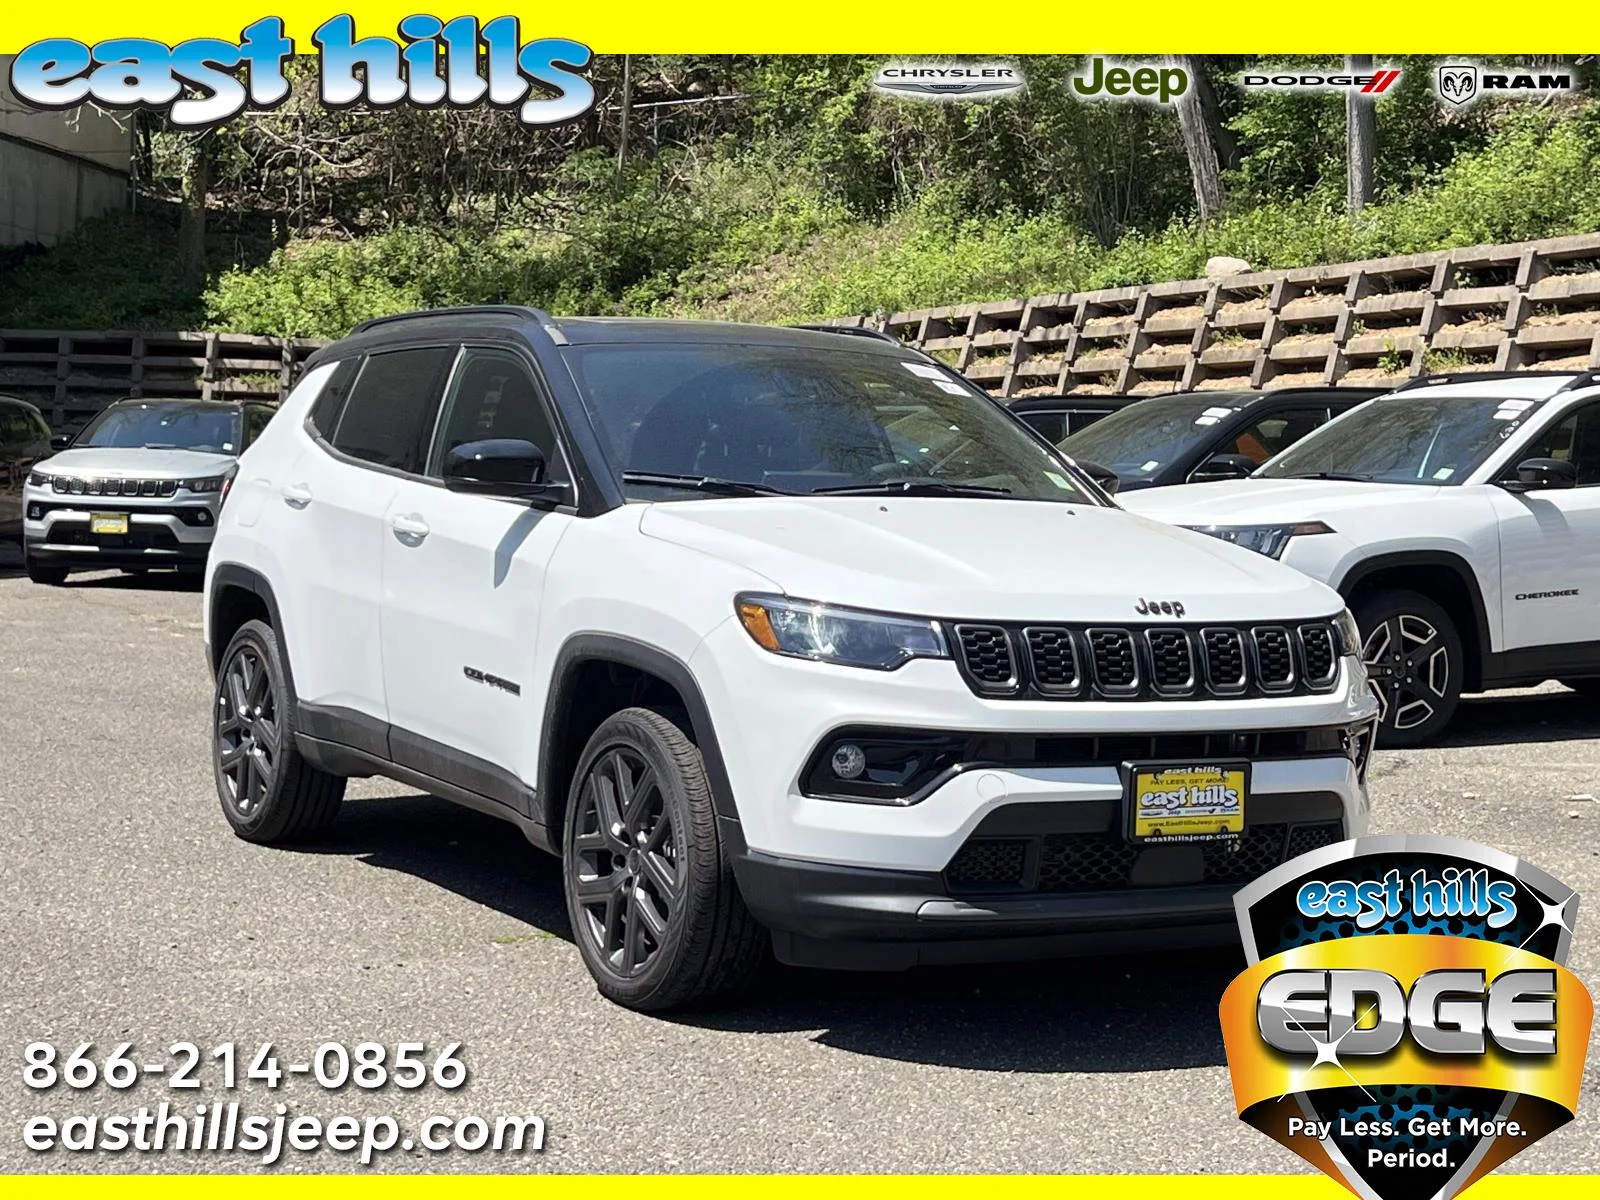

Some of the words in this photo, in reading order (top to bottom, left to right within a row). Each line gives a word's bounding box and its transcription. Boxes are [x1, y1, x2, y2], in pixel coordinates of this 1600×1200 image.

[1515, 588, 1579, 600] CHEROKEE
[1134, 598, 1185, 618] Jeep
[1164, 767, 1191, 775] east
[1194, 766, 1222, 774] hills
[1141, 787, 1188, 809] east
[1190, 784, 1239, 808] hills
[1144, 834, 1239, 843] easthillsjeep.com
